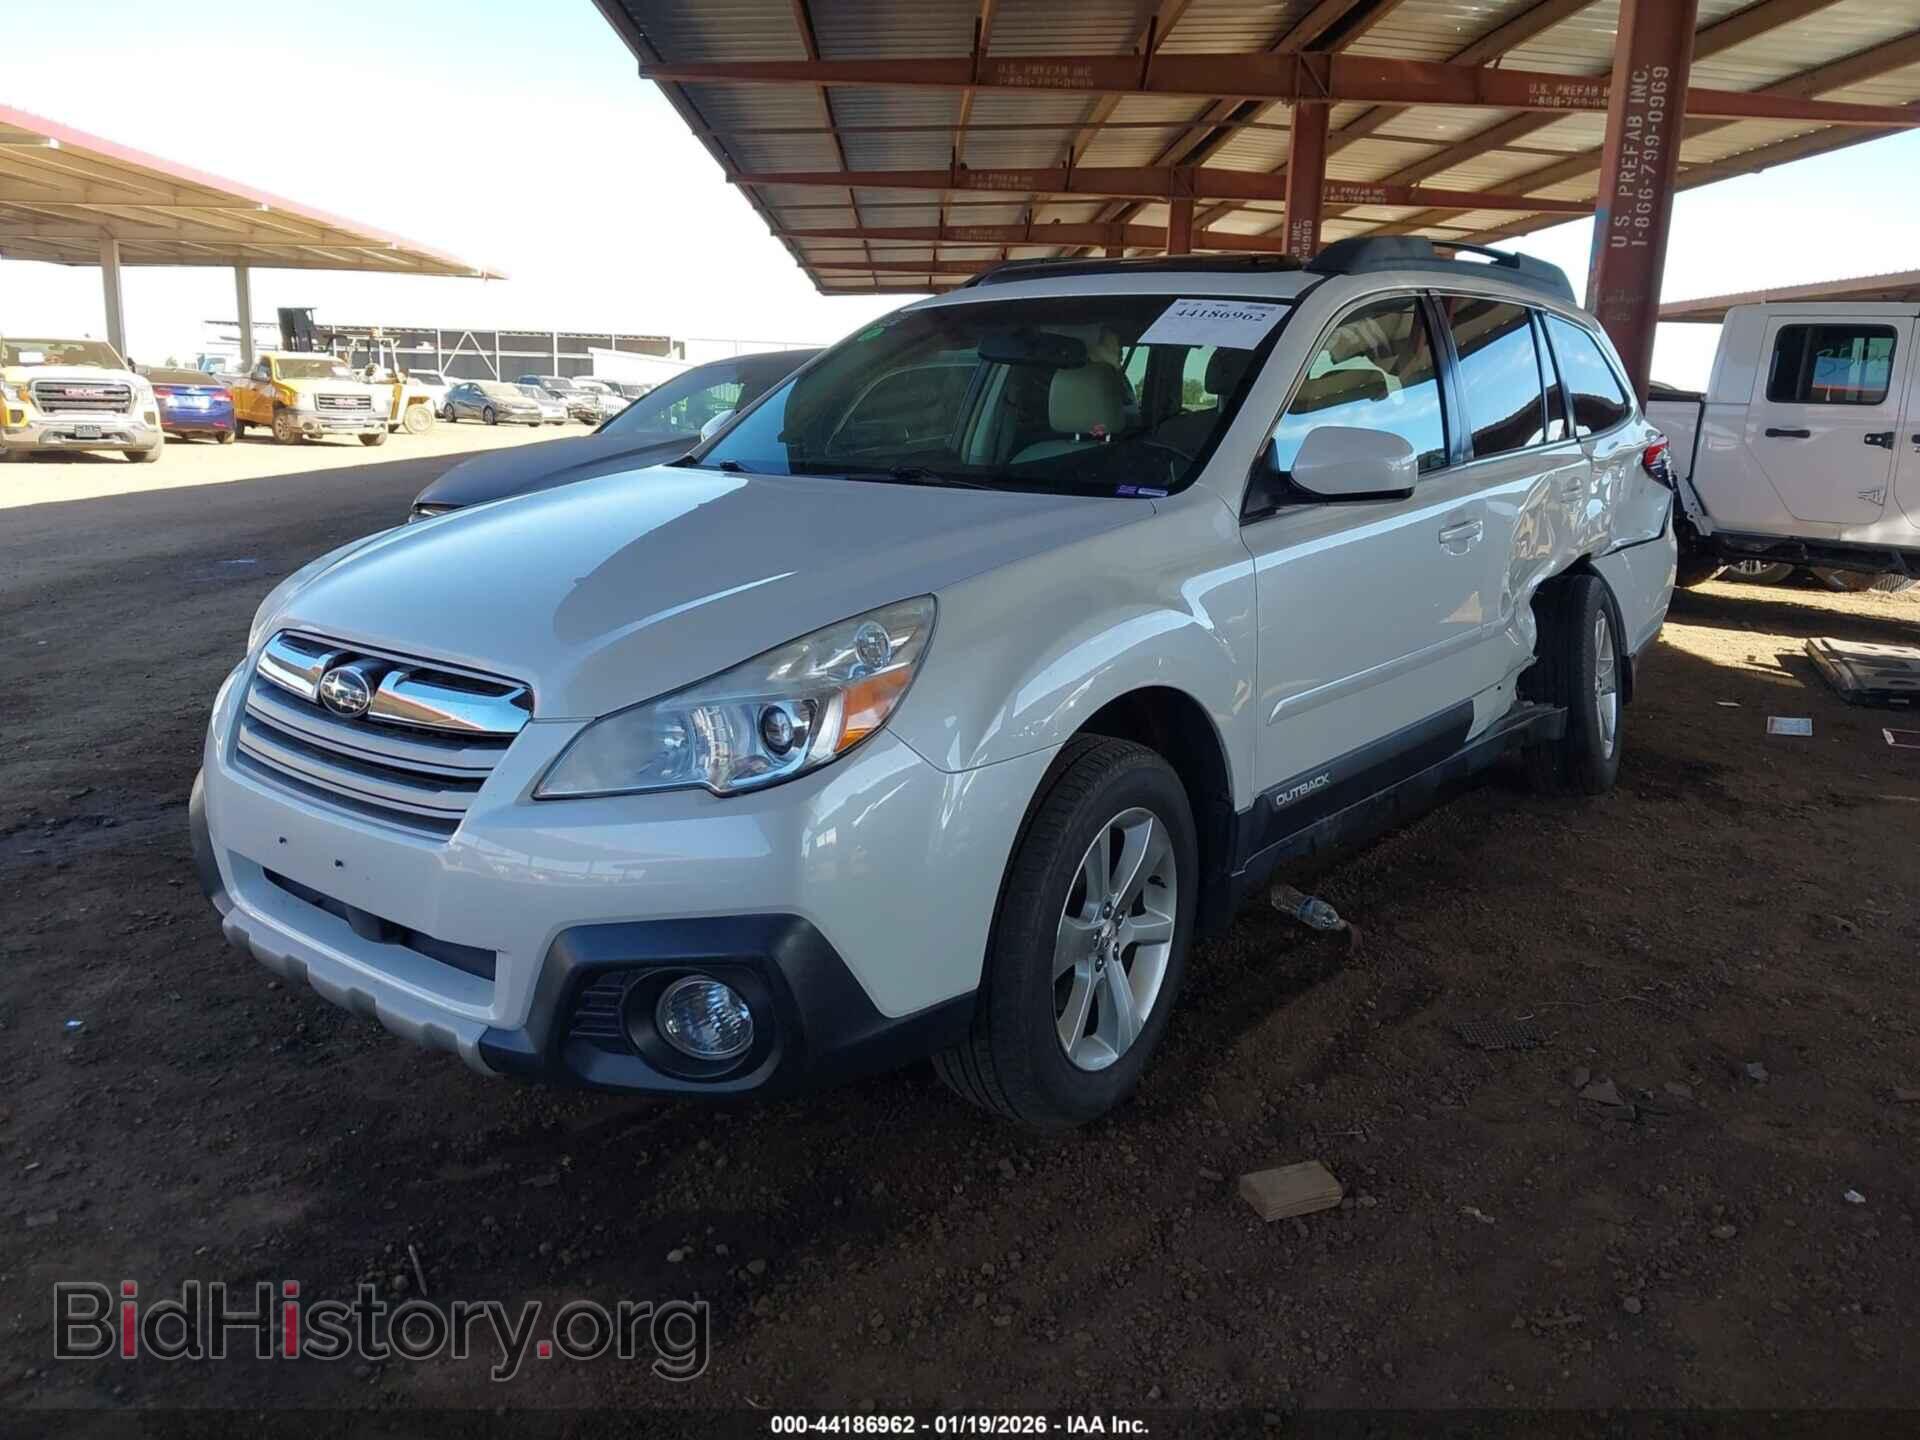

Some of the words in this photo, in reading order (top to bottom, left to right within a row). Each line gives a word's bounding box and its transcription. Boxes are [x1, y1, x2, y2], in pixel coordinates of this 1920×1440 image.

[1628, 63, 1650, 104] INC.
[1617, 115, 1644, 197] PREFAB
[1631, 65, 1670, 247] 1-866-799-0969
[1611, 208, 1633, 249] U.S.
[1176, 309, 1267, 322] 44186962
[1276, 773, 1329, 806] OUTBACK
